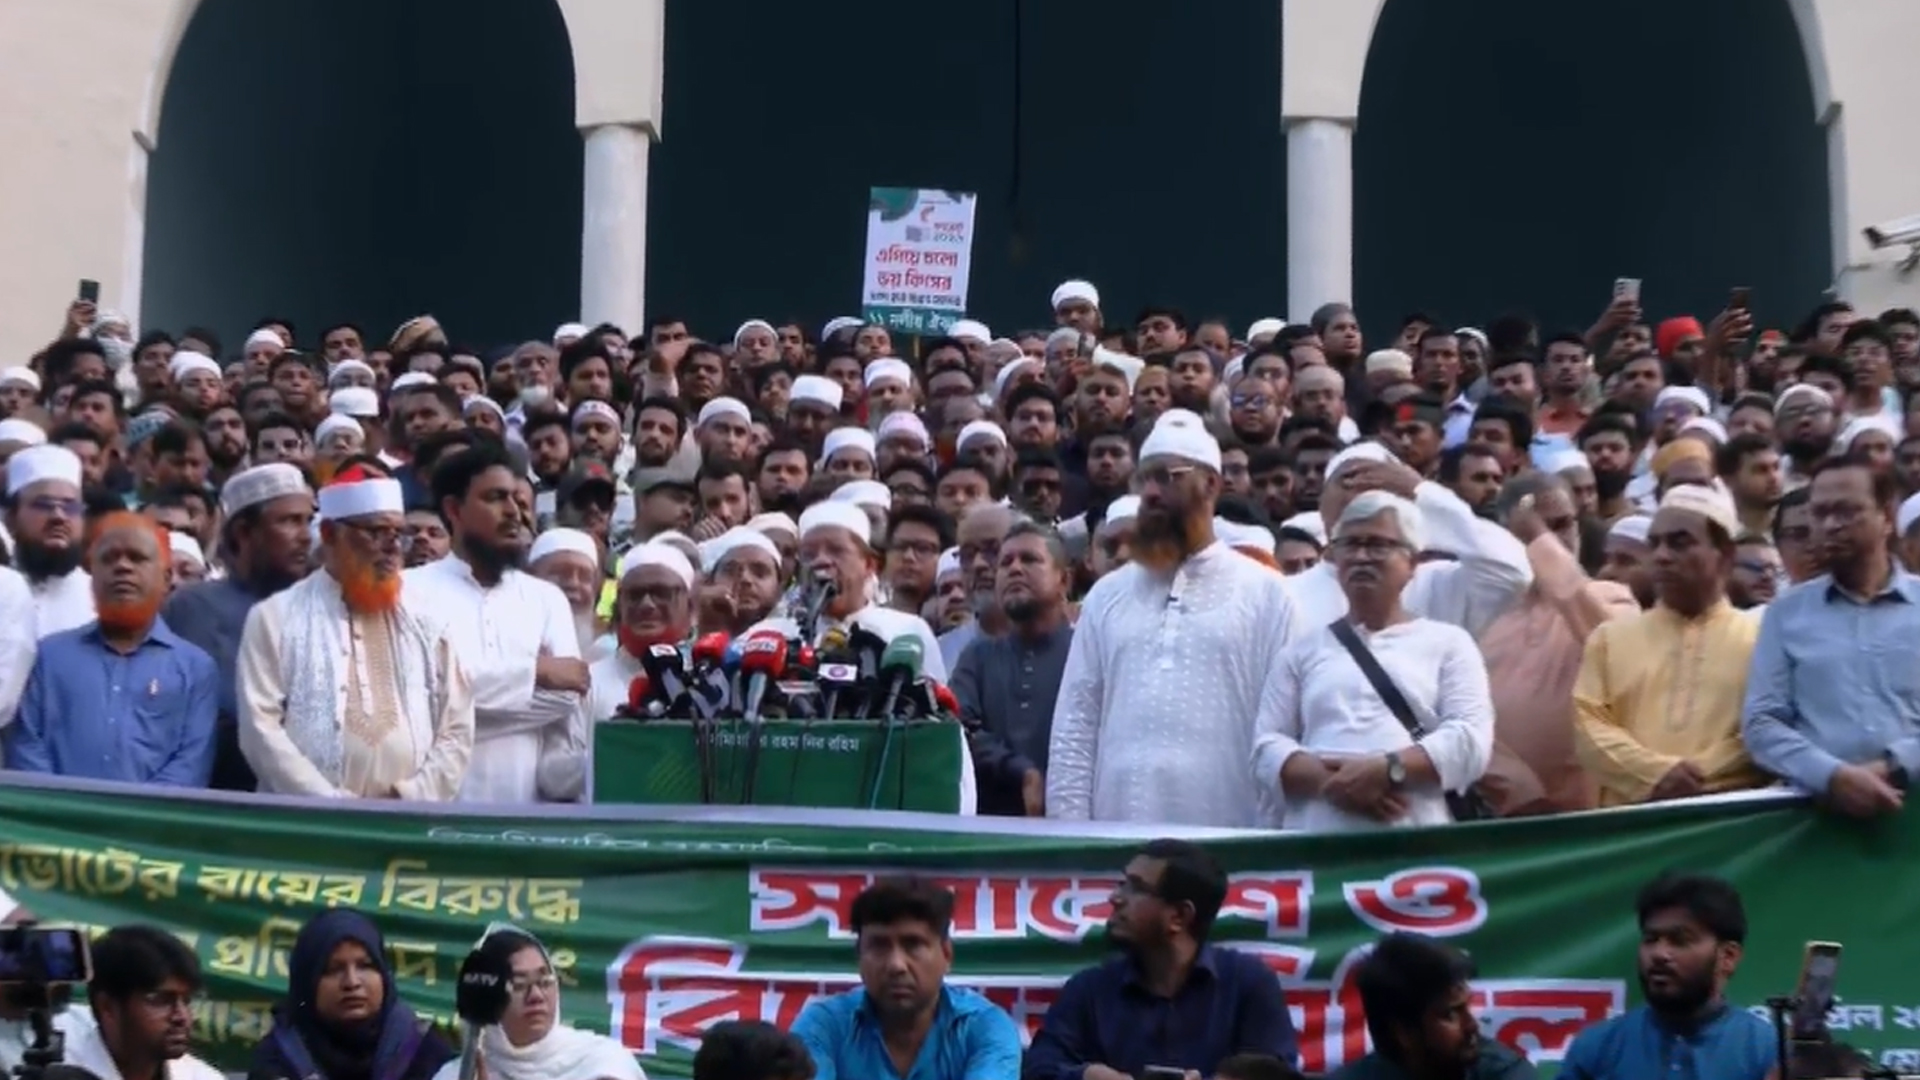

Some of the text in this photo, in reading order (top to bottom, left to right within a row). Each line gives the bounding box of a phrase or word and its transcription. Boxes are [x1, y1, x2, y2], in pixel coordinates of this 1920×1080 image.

[196, 864, 365, 911] রায়ের
[378, 858, 582, 922] বিরুদ্ধে
[1342, 866, 1488, 937] ও
[1892, 1003, 1920, 1031] ২
